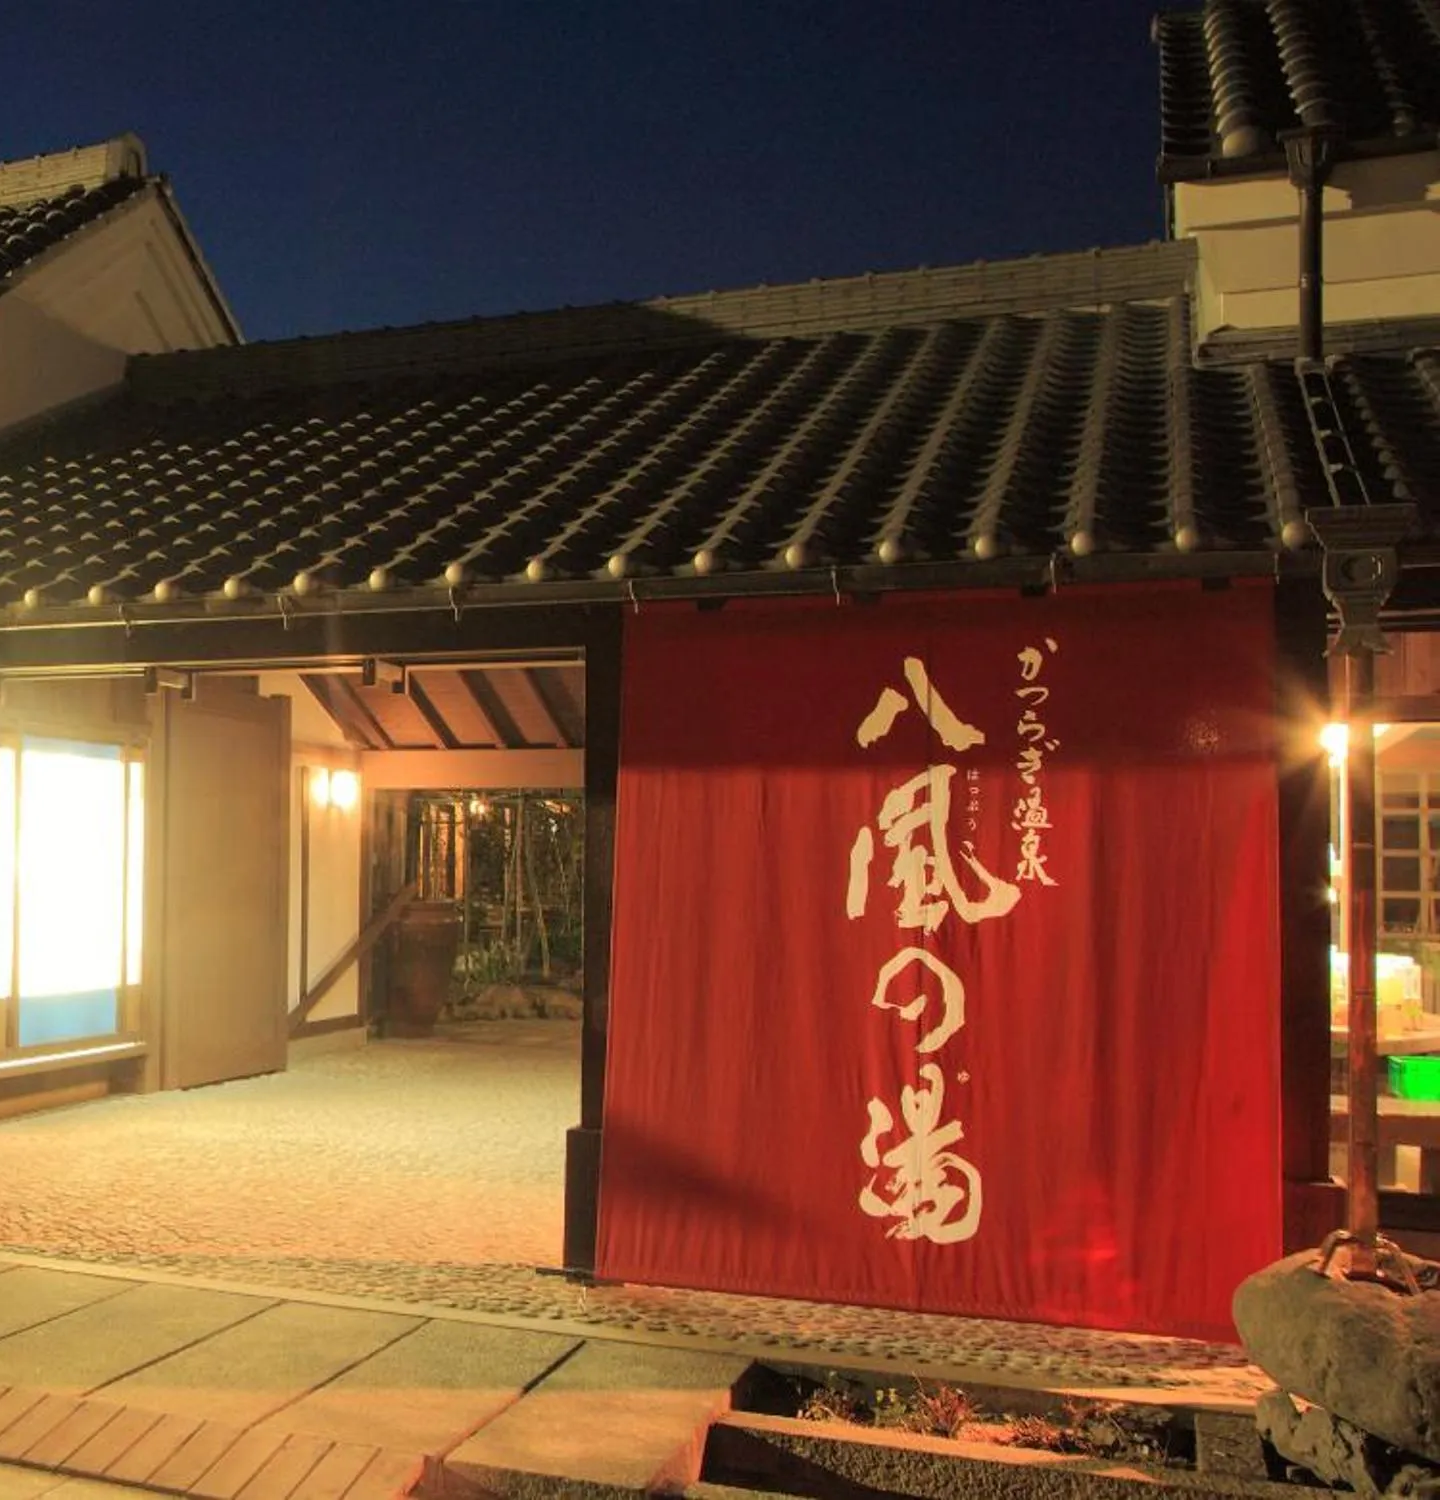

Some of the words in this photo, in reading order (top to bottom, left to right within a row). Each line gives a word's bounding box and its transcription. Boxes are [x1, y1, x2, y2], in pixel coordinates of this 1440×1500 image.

[846, 656, 1021, 1244] 八風の湯
[1011, 637, 1060, 887] かつらぎ温泉
